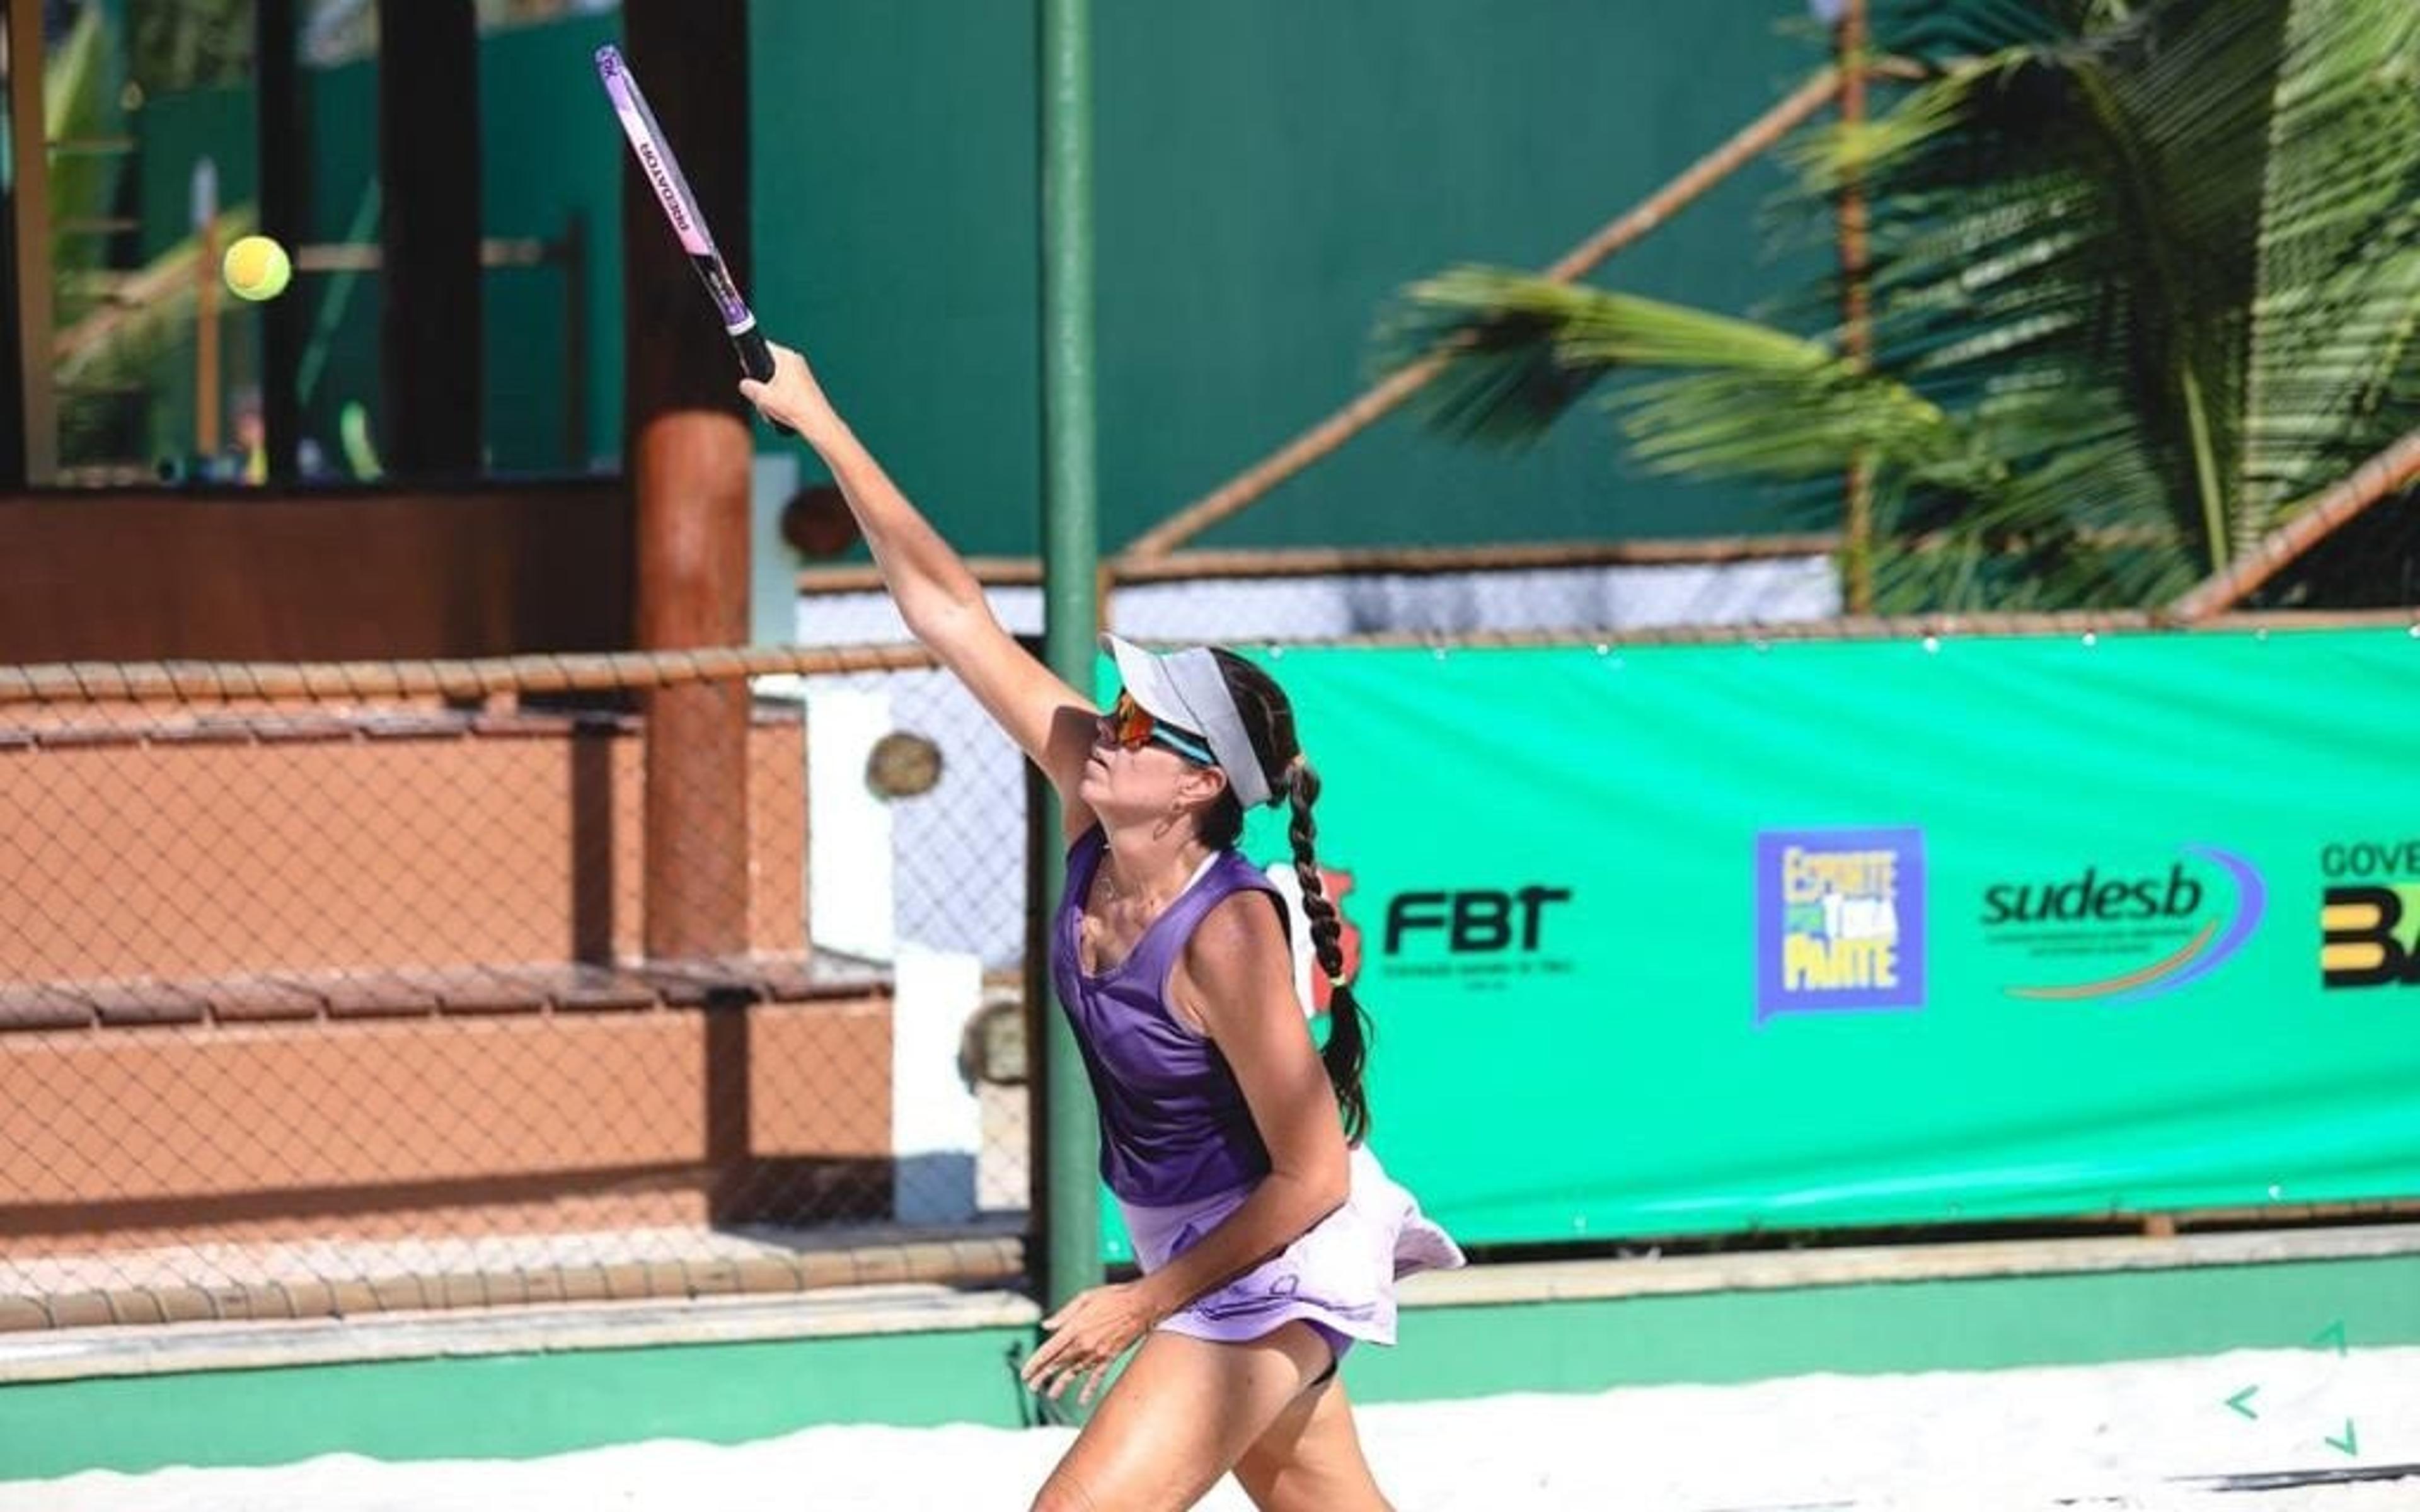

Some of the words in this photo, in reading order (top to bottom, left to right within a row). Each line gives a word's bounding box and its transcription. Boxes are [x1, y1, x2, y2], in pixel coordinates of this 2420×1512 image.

[640, 143, 689, 231] PREDATOR
[1383, 886, 1572, 955] FBT
[1981, 862, 2202, 925] sudesb
[1783, 933, 1899, 991] PARTE
